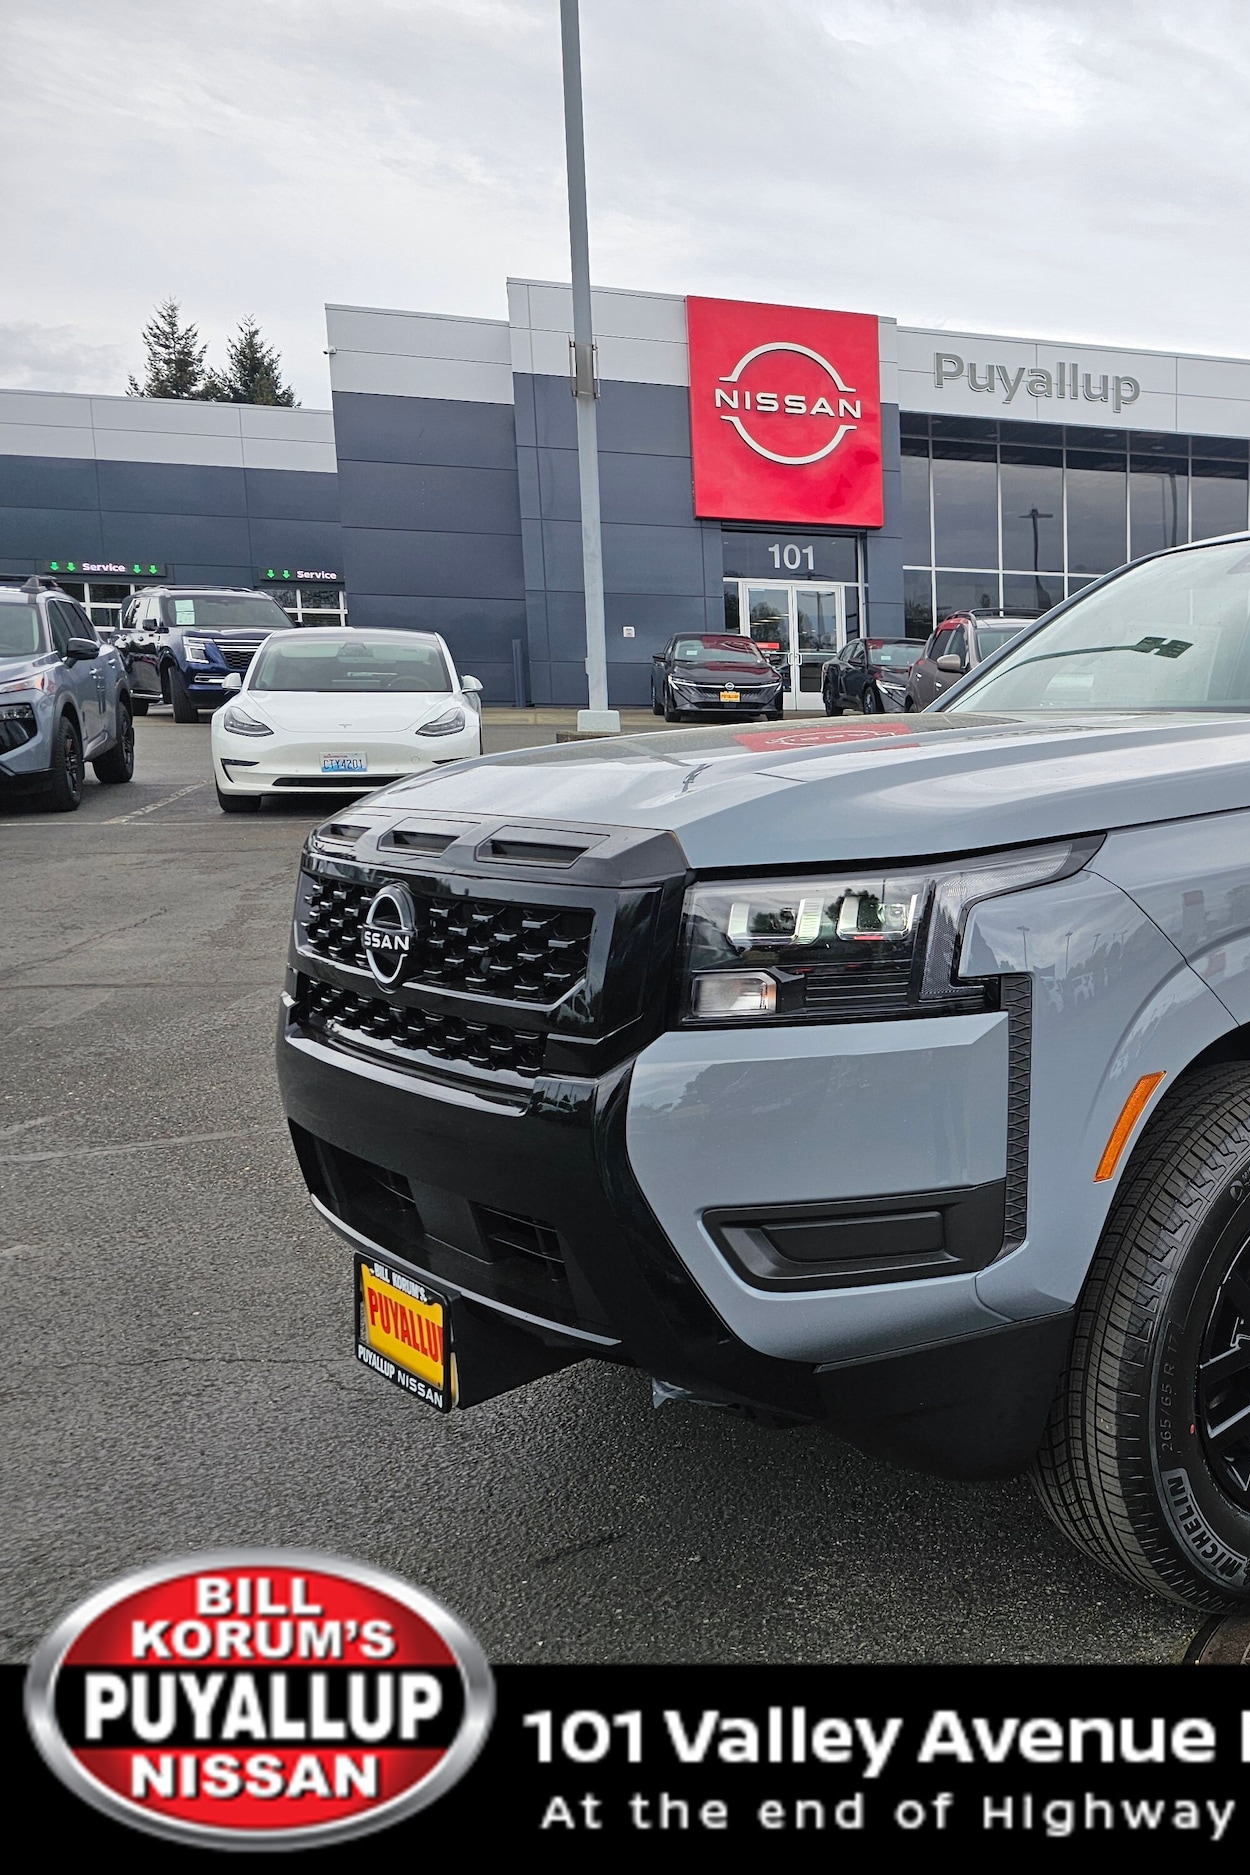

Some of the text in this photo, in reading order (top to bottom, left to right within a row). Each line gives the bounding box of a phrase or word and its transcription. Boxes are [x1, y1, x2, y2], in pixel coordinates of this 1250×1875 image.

[934, 352, 1141, 413] Puyallup
[714, 388, 862, 419] NISSAN
[82, 562, 126, 573] Service
[768, 543, 814, 570] 101
[296, 570, 337, 580] Service
[364, 930, 410, 951] SSAN
[374, 1263, 391, 1283] BILL
[358, 1344, 444, 1409] PUYALLUP NISSAN
[1167, 1476, 1243, 1578] MICHELIN
